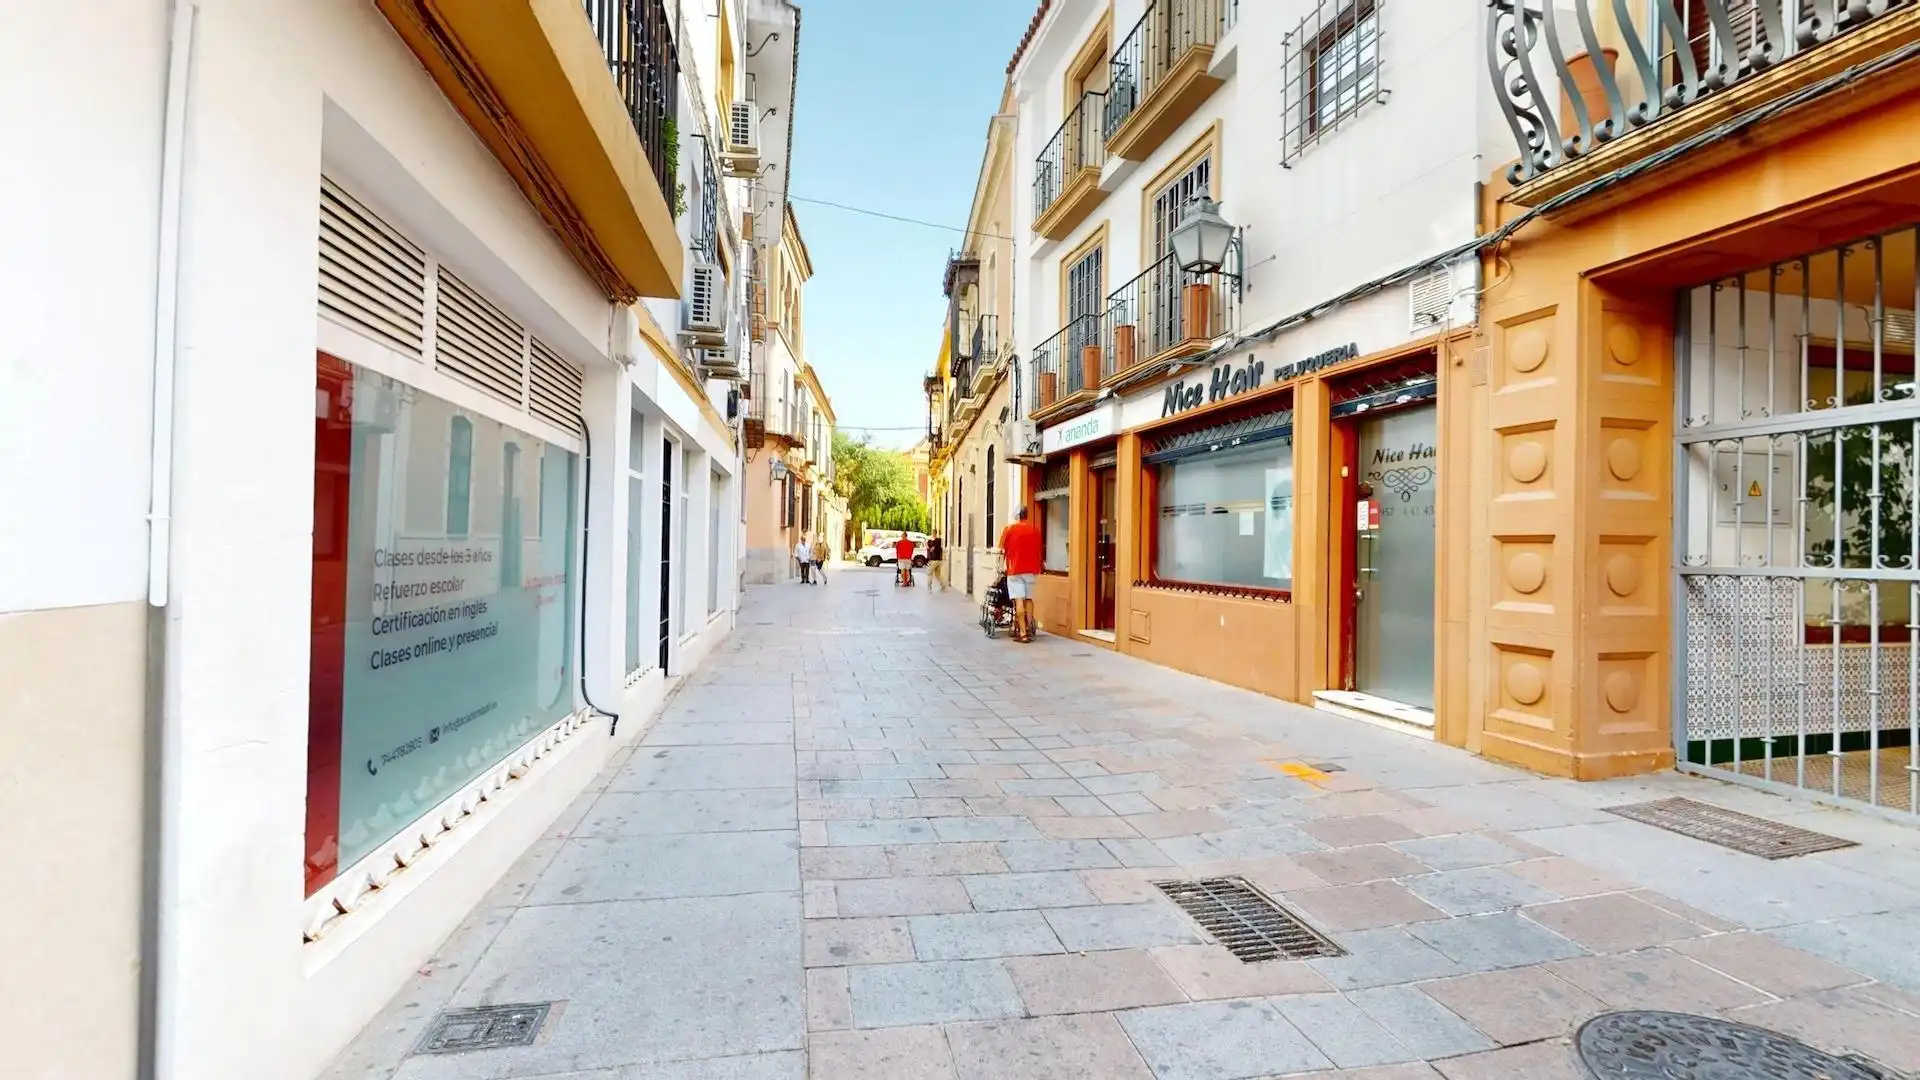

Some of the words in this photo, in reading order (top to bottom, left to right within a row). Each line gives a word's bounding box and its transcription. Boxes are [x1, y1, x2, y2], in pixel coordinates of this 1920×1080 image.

[1161, 380, 1203, 418] Nice
[1208, 353, 1265, 402] Hair
[1273, 342, 1360, 382] PELUQUERIA
[1064, 416, 1099, 443] ananda
[1372, 447, 1405, 465] Nice
[374, 547, 415, 568] Clases
[416, 546, 449, 566] desde
[450, 548, 464, 565] los
[373, 580, 428, 601] Refuerzo
[429, 575, 465, 595] escolar
[371, 605, 446, 636] Certificación
[447, 606, 461, 621] en
[462, 598, 489, 620] inglés
[370, 645, 412, 670] Clases
[413, 635, 448, 659] online
[447, 635, 456, 653] y
[456, 620, 500, 651] presencial
